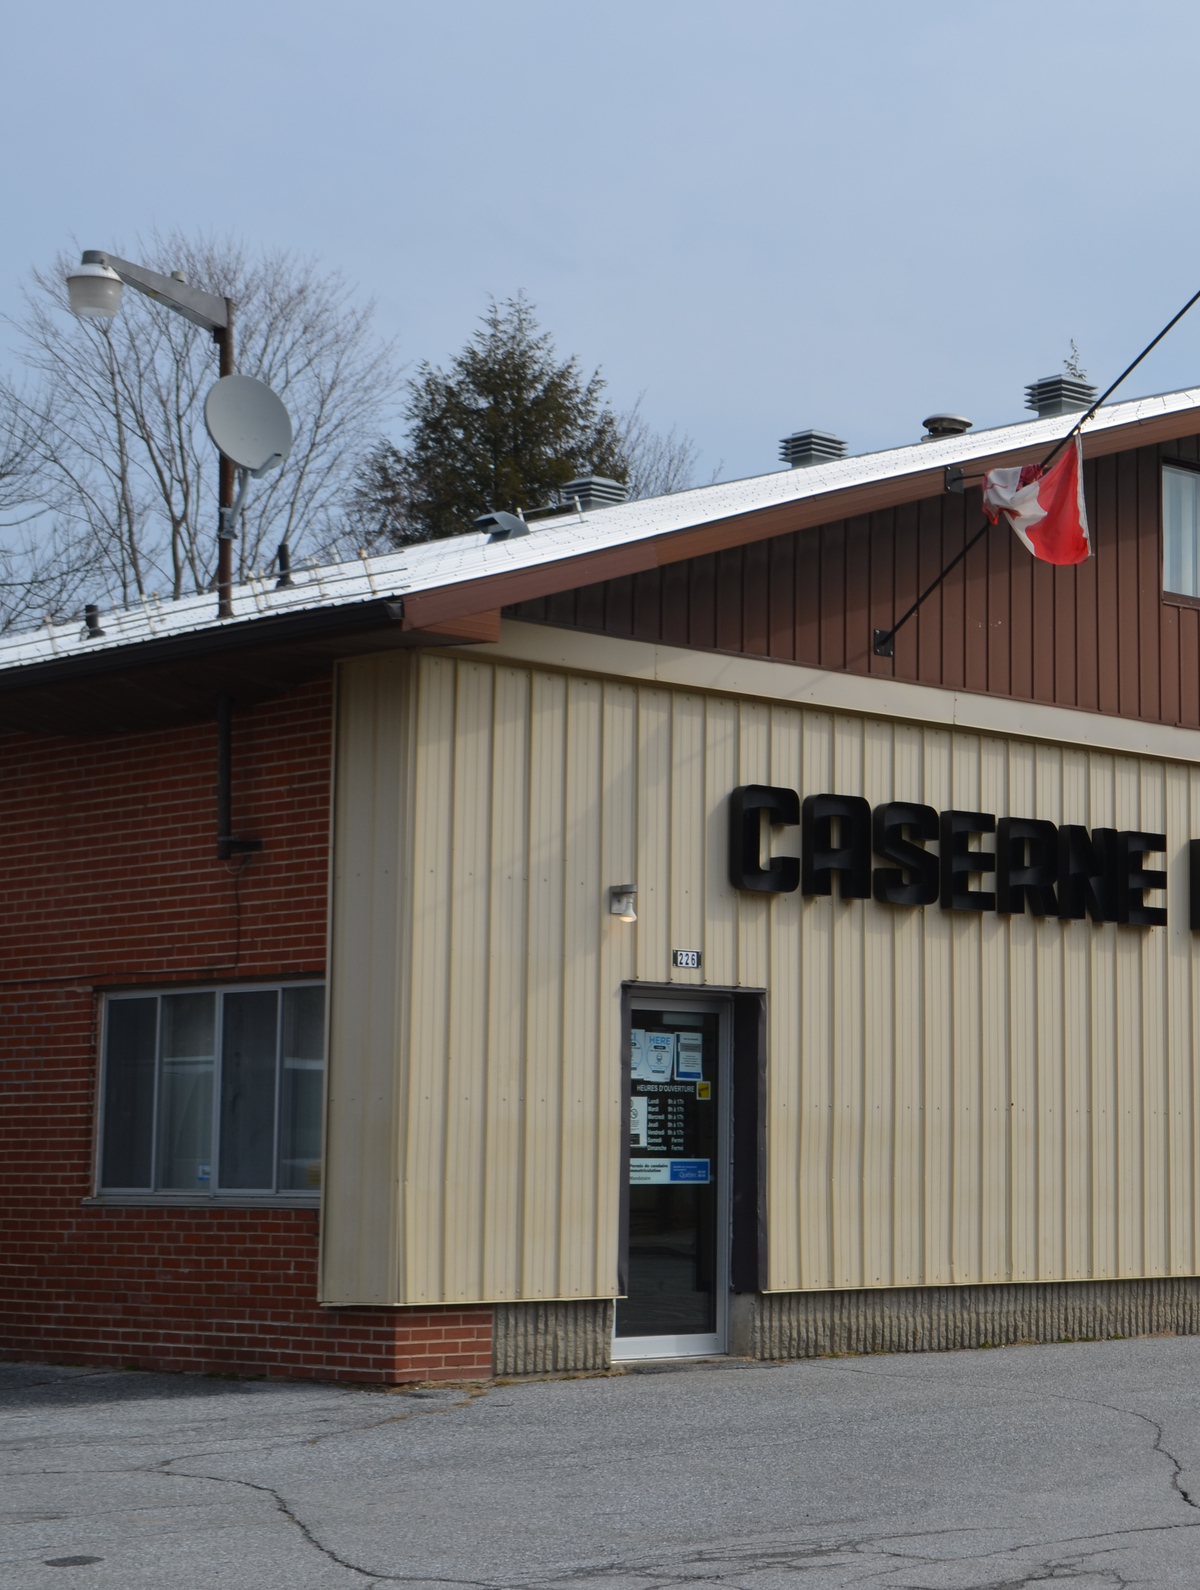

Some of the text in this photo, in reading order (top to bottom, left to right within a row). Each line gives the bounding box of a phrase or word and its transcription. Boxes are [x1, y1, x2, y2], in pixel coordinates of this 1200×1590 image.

[730, 784, 1167, 927] CASERNE
[679, 952, 696, 966] 226
[649, 1036, 671, 1045] HERE
[636, 1084, 659, 1092] HEURES
